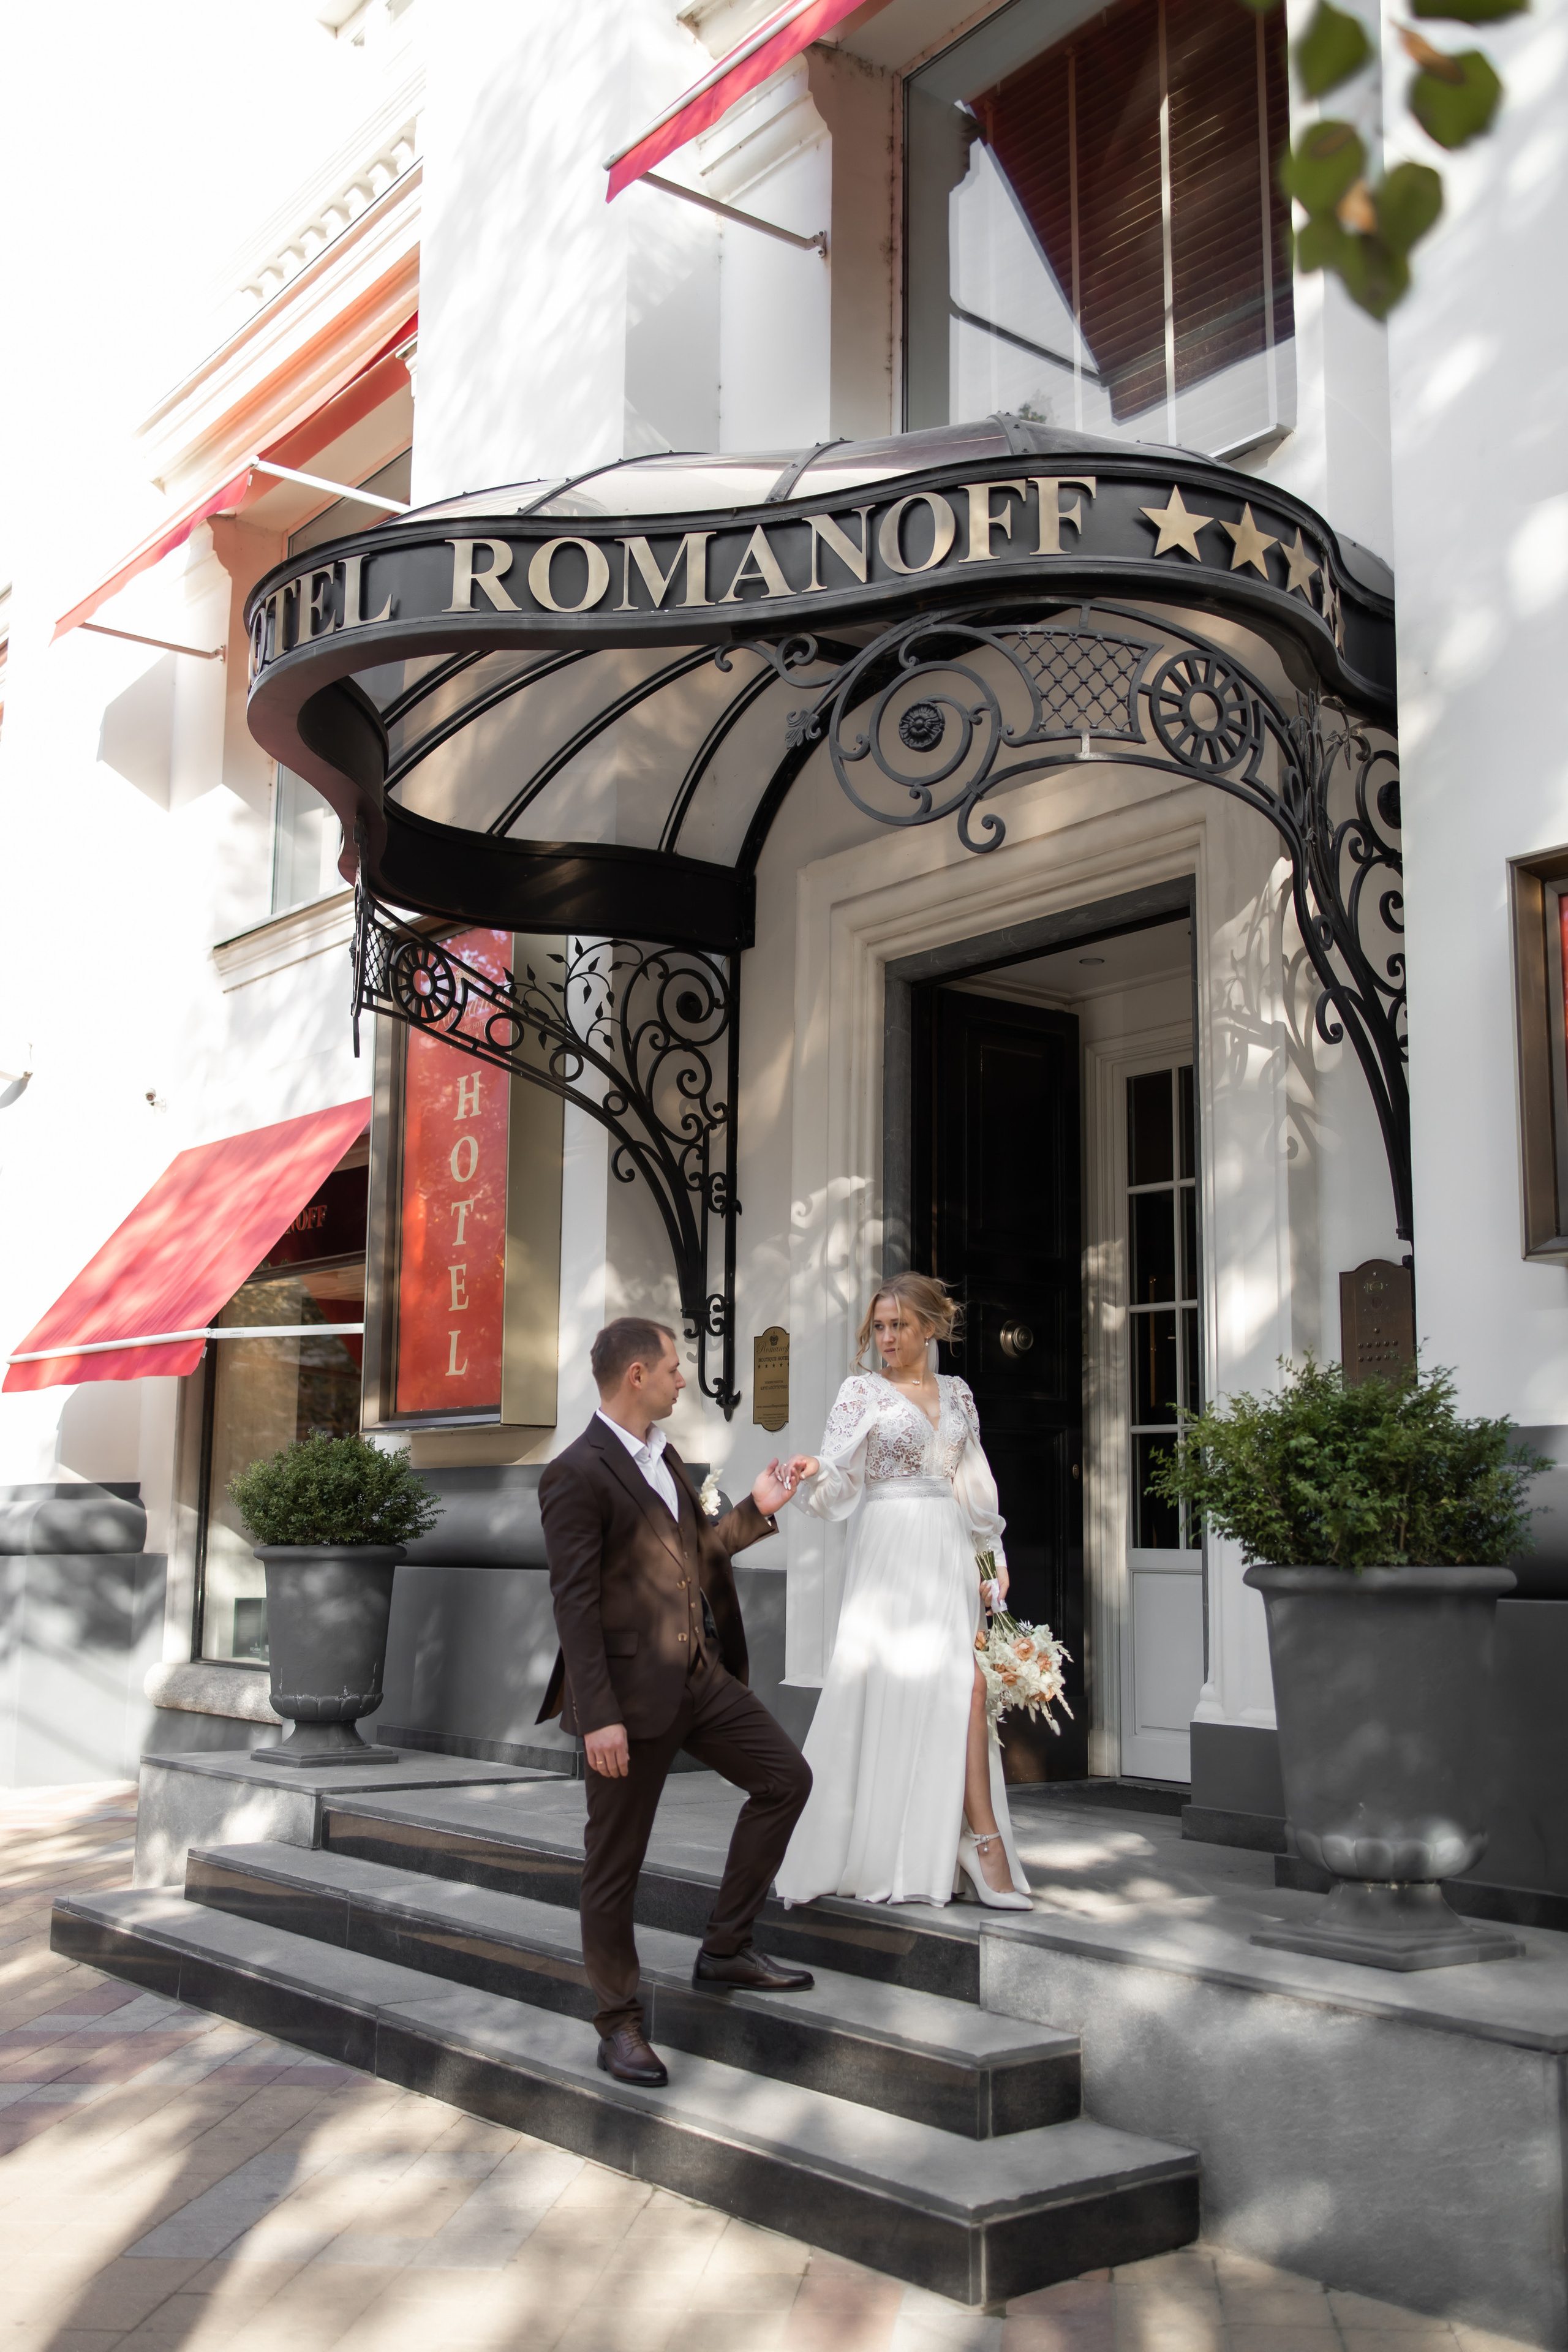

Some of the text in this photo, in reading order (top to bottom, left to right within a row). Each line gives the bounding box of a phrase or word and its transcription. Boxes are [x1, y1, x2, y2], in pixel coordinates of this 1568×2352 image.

[249, 476, 1096, 681] OTEL ROMANOFF
[445, 1071, 481, 1377] HOTEL
[756, 1341, 790, 1354] Romanoff
